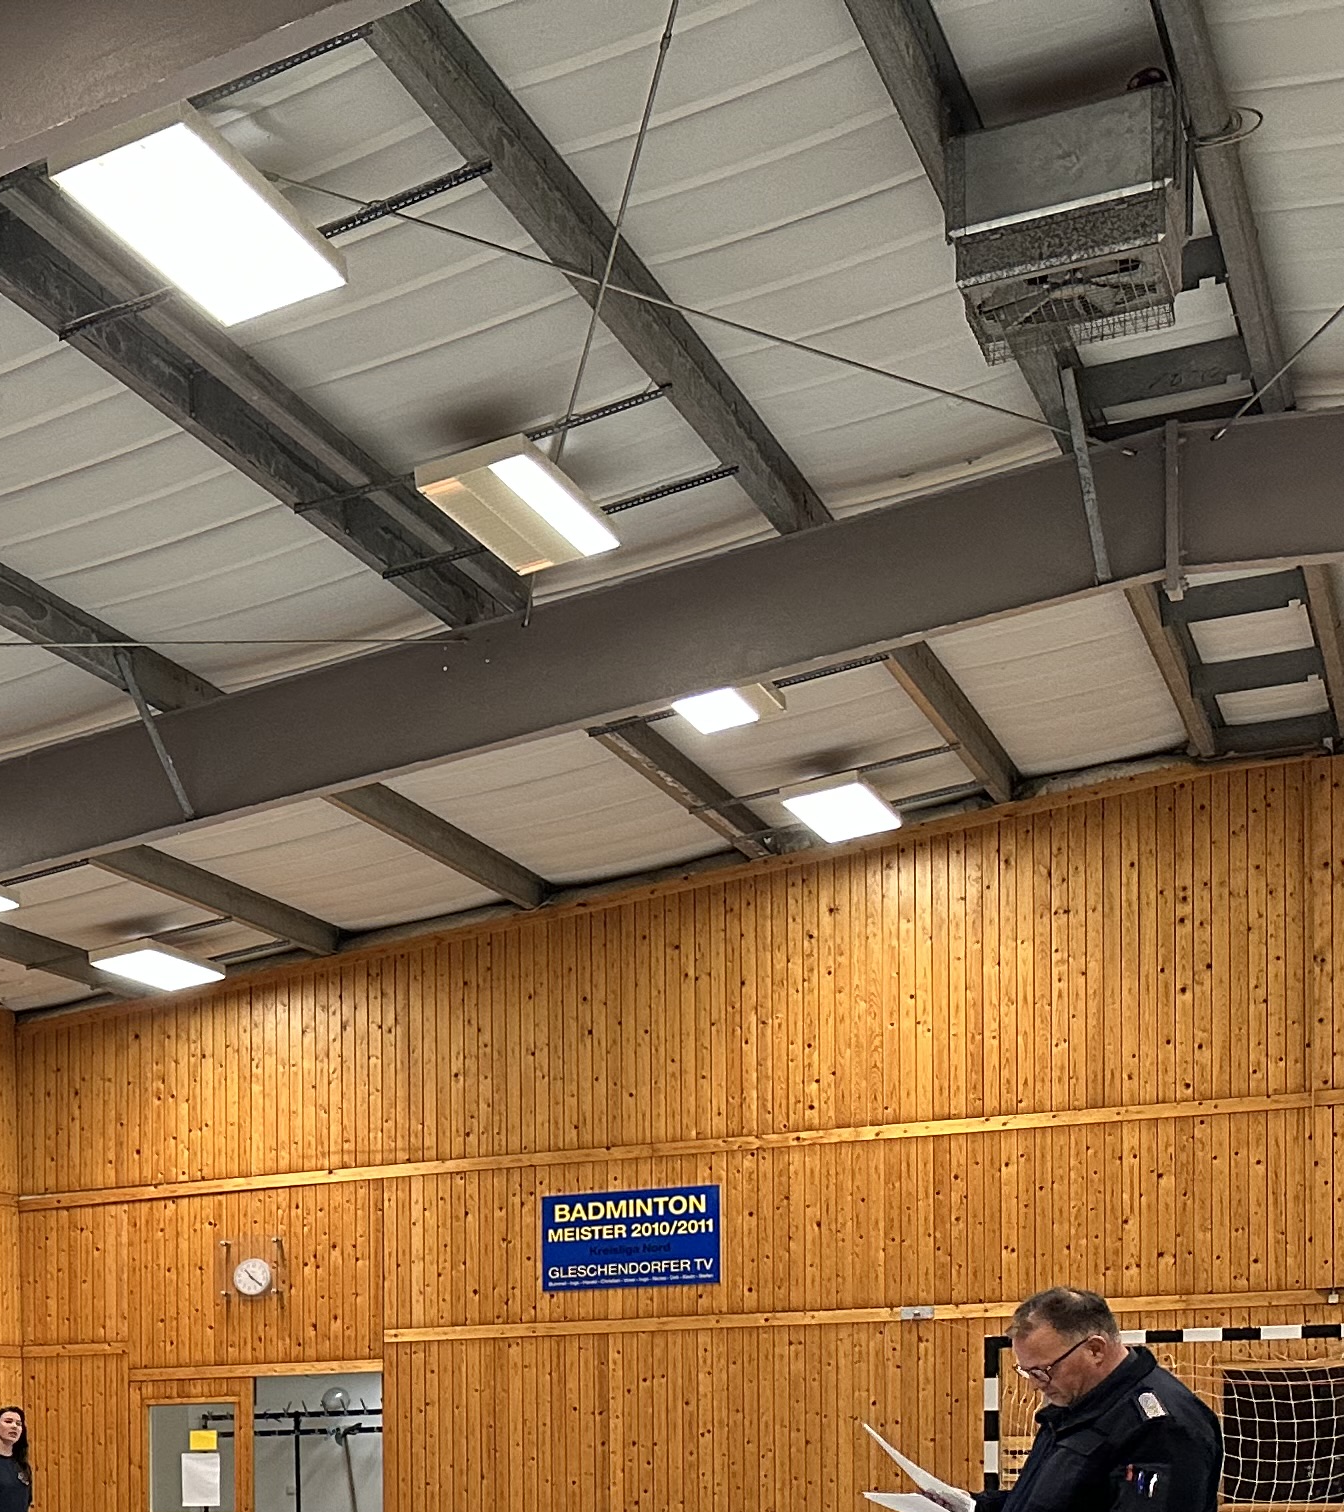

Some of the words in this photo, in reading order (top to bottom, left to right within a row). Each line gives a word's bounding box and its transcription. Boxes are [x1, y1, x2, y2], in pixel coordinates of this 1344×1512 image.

[554, 1194, 706, 1223] BADMINTON
[548, 1224, 627, 1242] MEISTER
[631, 1219, 714, 1238] 2010/2011
[642, 1242, 671, 1253] Nord
[548, 1260, 691, 1279] GLESCHENDORFER
[694, 1258, 714, 1270] TV
